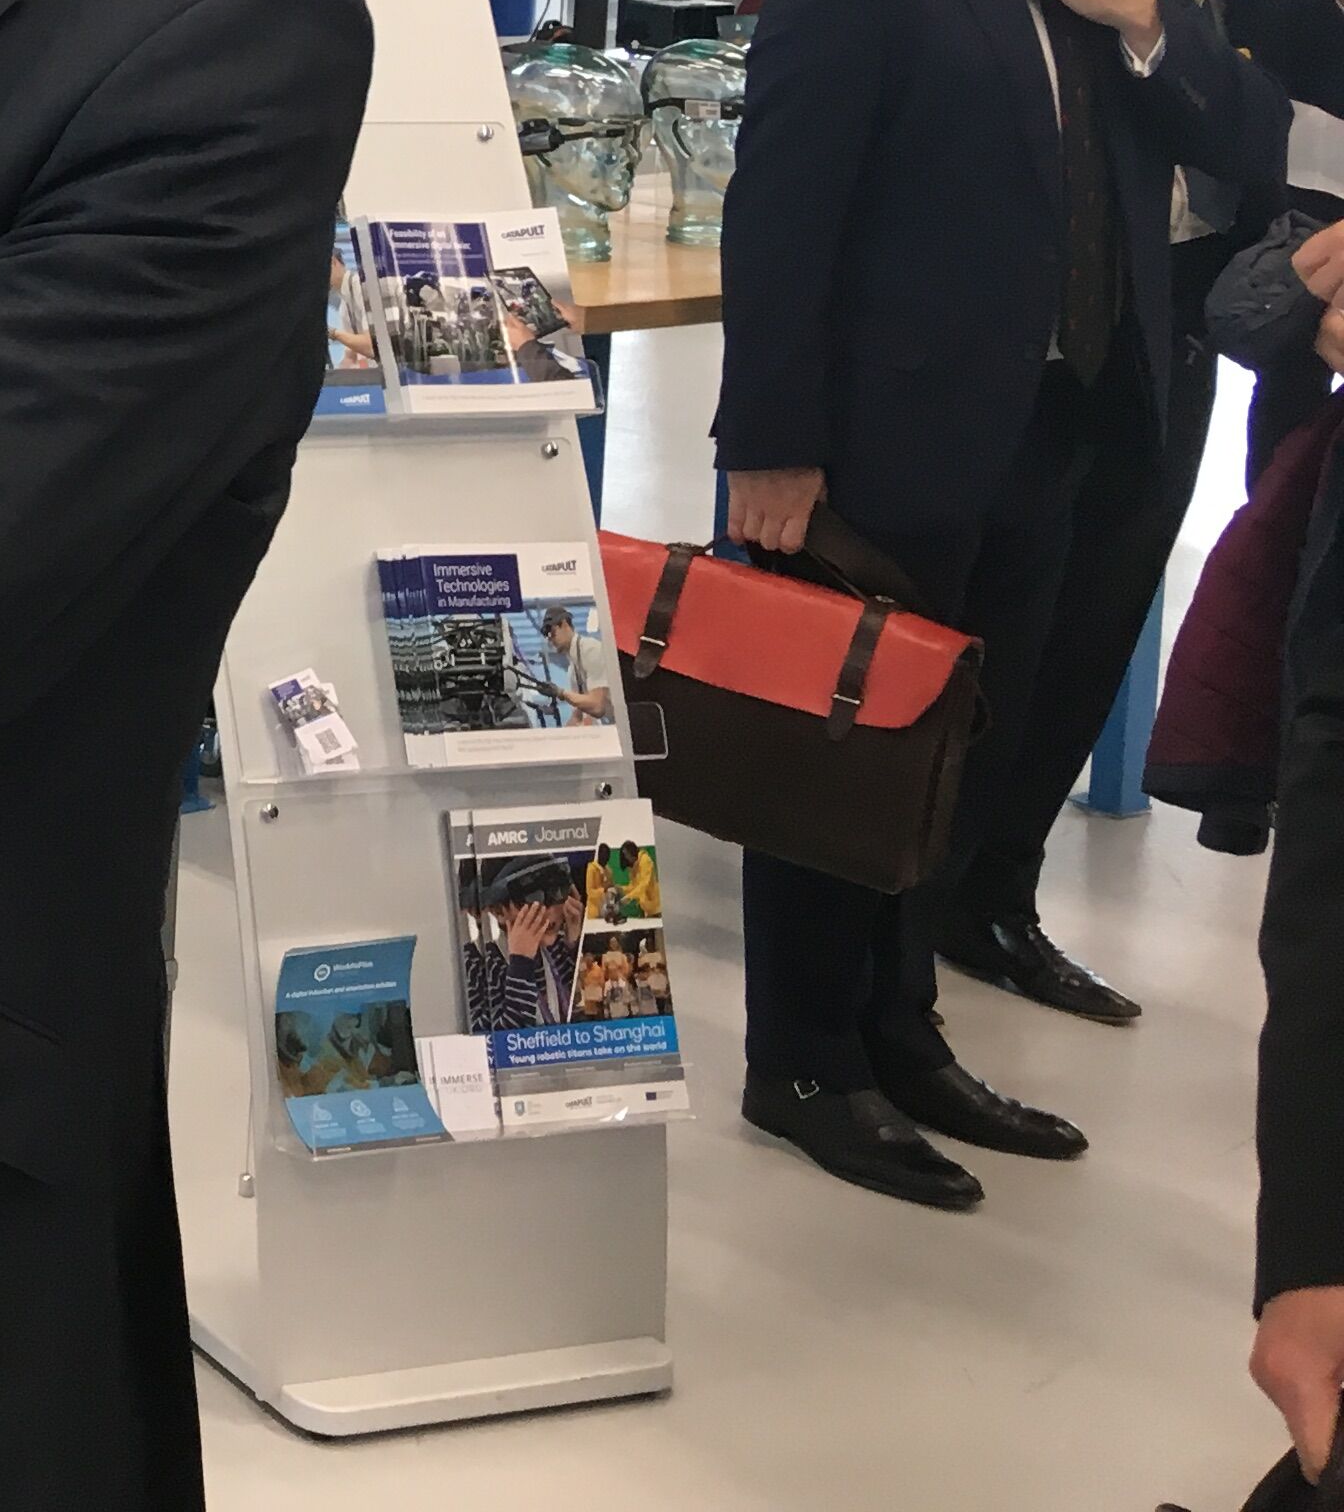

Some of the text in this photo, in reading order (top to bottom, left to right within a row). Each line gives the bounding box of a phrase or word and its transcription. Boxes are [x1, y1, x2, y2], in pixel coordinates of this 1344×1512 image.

[433, 563, 493, 576] Immersive
[435, 579, 510, 595] Technologies
[438, 595, 511, 609] in Manufacturing
[488, 822, 590, 846] AMRC Journal
[507, 1020, 665, 1052] Sheffield to Shanghai
[509, 1040, 667, 1065] Young robotic titans take on the world
[440, 1073, 484, 1086] IMMERSE
